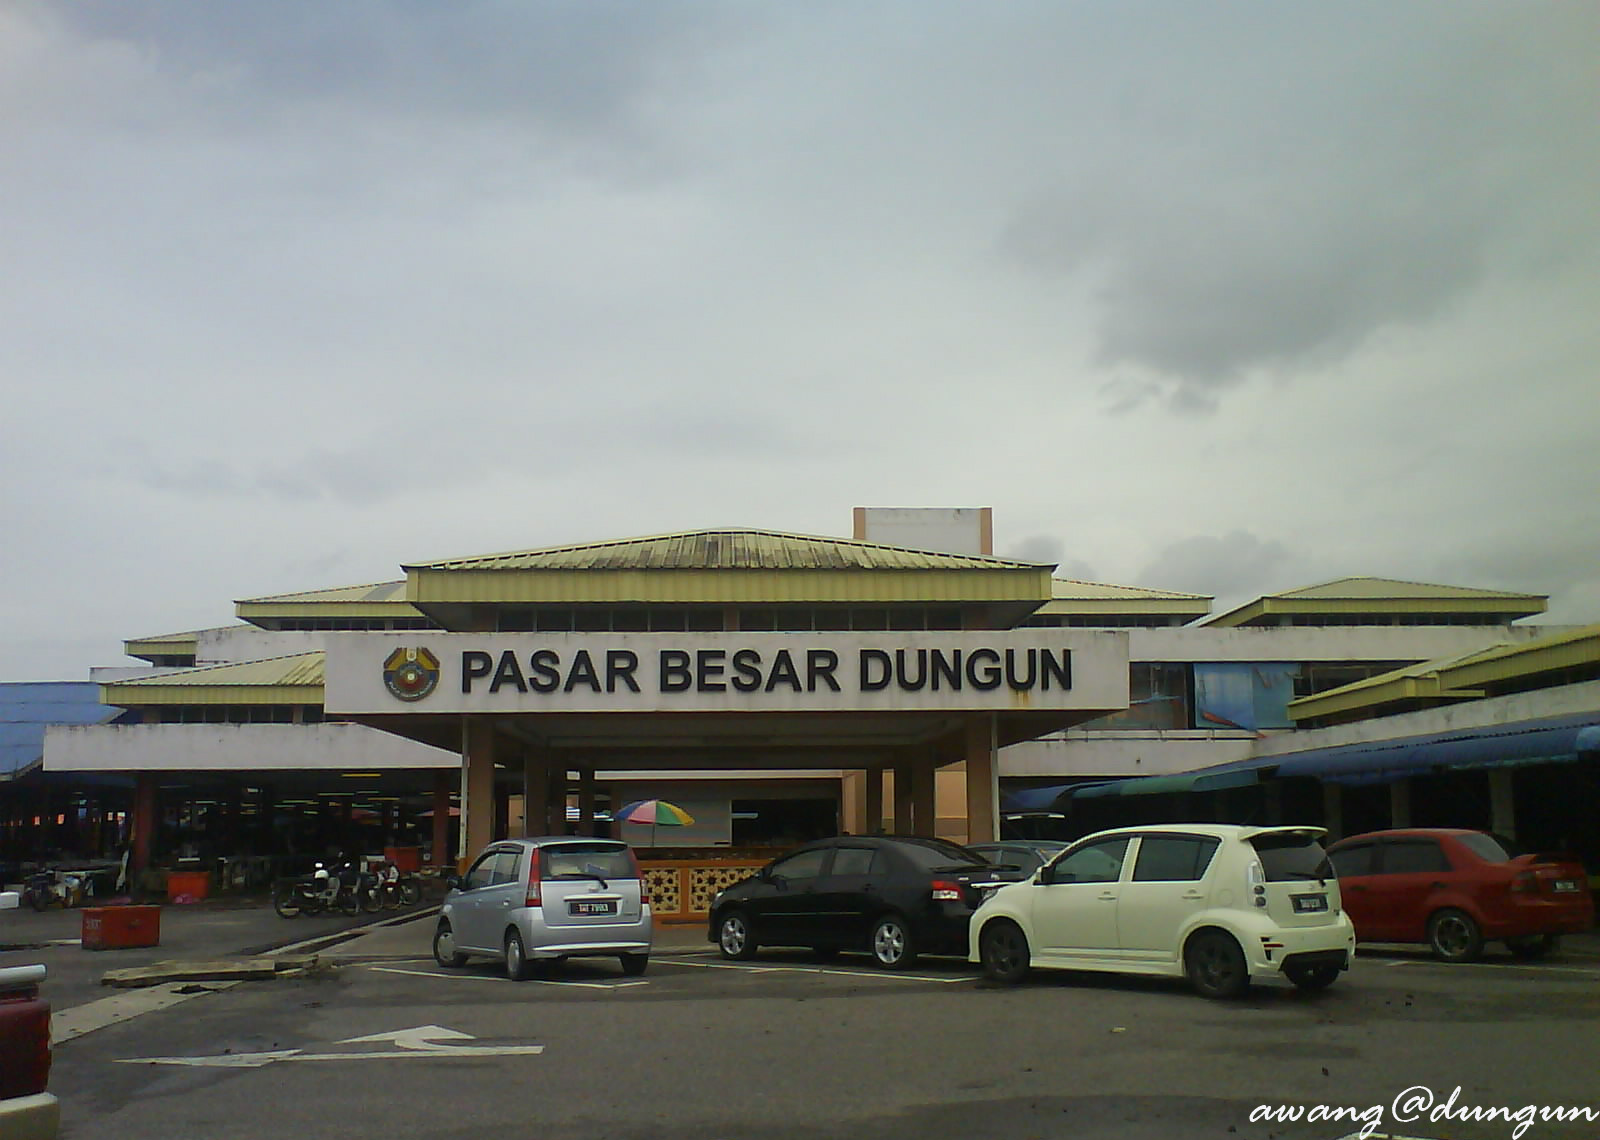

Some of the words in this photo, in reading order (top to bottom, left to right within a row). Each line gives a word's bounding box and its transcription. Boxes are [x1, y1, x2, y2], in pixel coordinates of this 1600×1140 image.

[461, 650, 640, 694] PASAR
[659, 649, 842, 693] BESAR
[859, 648, 1073, 694] DUNGUN
